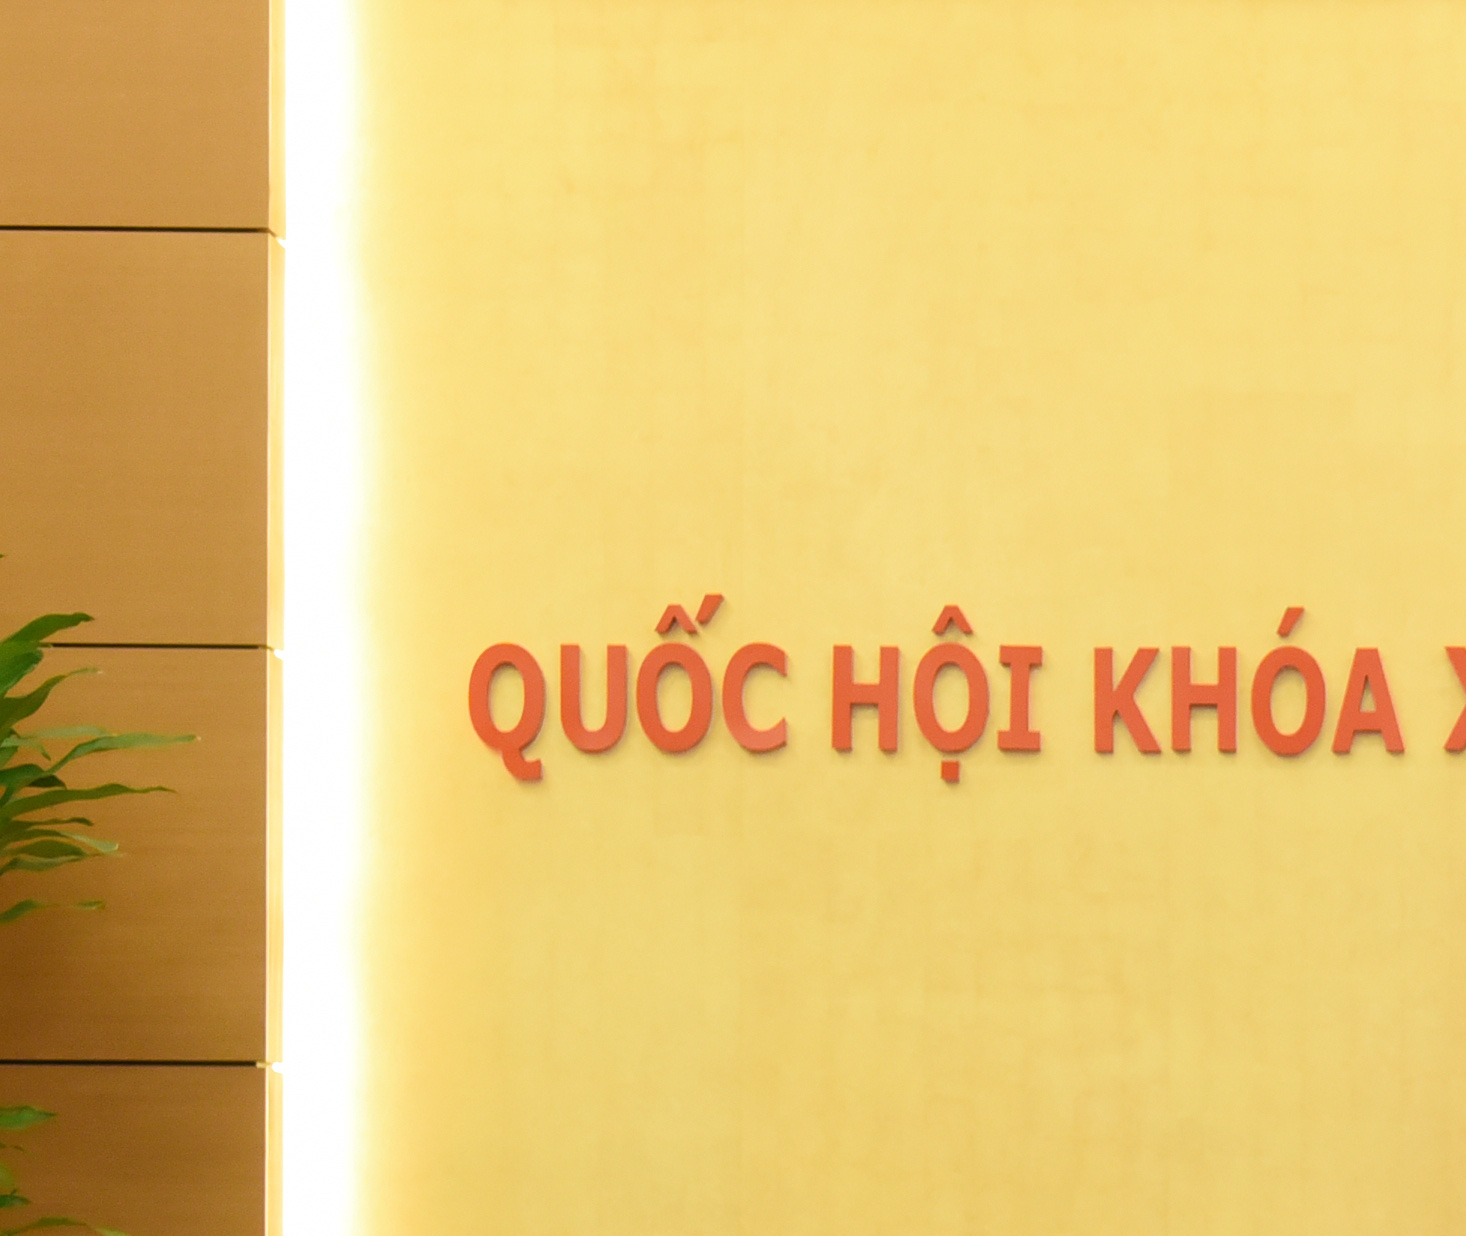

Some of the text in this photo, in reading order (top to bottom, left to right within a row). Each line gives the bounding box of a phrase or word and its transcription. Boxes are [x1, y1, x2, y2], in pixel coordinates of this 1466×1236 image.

[467, 594, 788, 782] QUỐC
[831, 604, 1043, 783] HỘI
[1094, 606, 1406, 756] KHÓA
